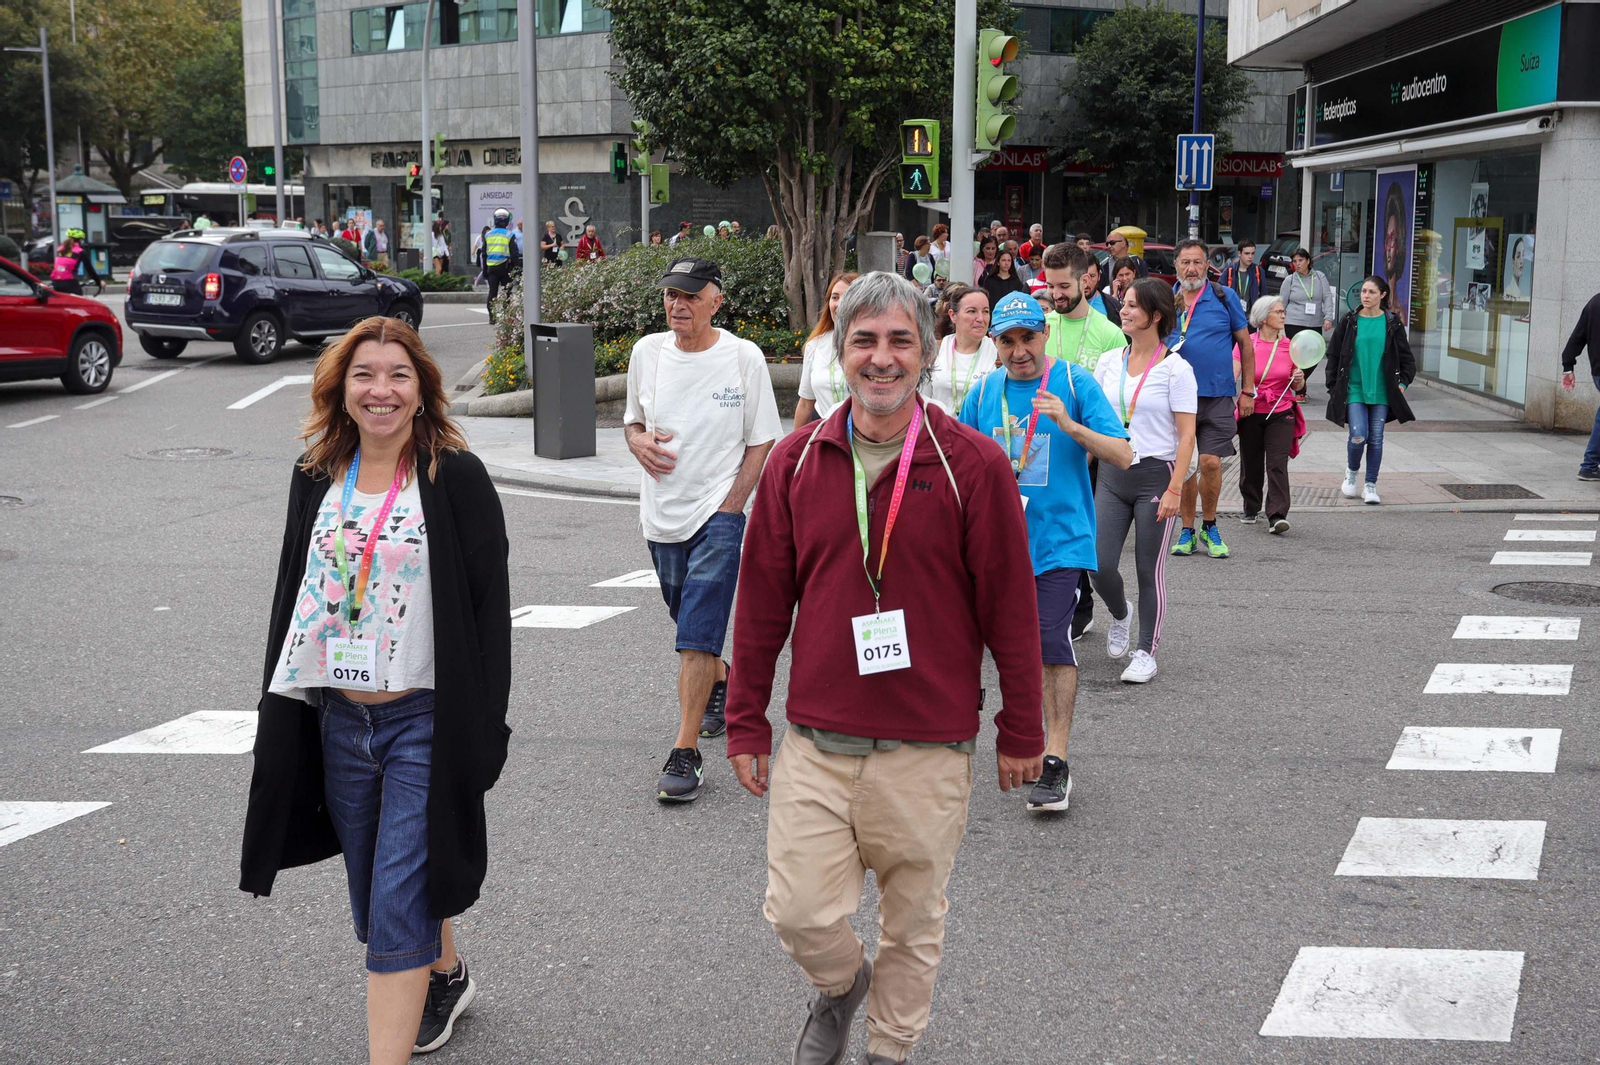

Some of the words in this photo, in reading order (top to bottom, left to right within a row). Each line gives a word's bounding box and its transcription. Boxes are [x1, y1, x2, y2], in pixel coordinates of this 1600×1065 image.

[1520, 52, 1540, 72] Suiza
[1401, 72, 1447, 102] audiocentro
[1323, 97, 1357, 122] federópticos
[371, 149, 473, 168] FARMIA
[991, 150, 1041, 167] ONLAB
[479, 191, 513, 201] ¿ANSIEDAD?
[862, 617, 896, 627] ASPANAEX
[873, 626, 897, 637] Plena
[335, 642, 368, 651] ASPANAEX
[864, 643, 902, 661] 0175
[345, 651, 368, 661] Plena
[333, 667, 370, 682] 0176
